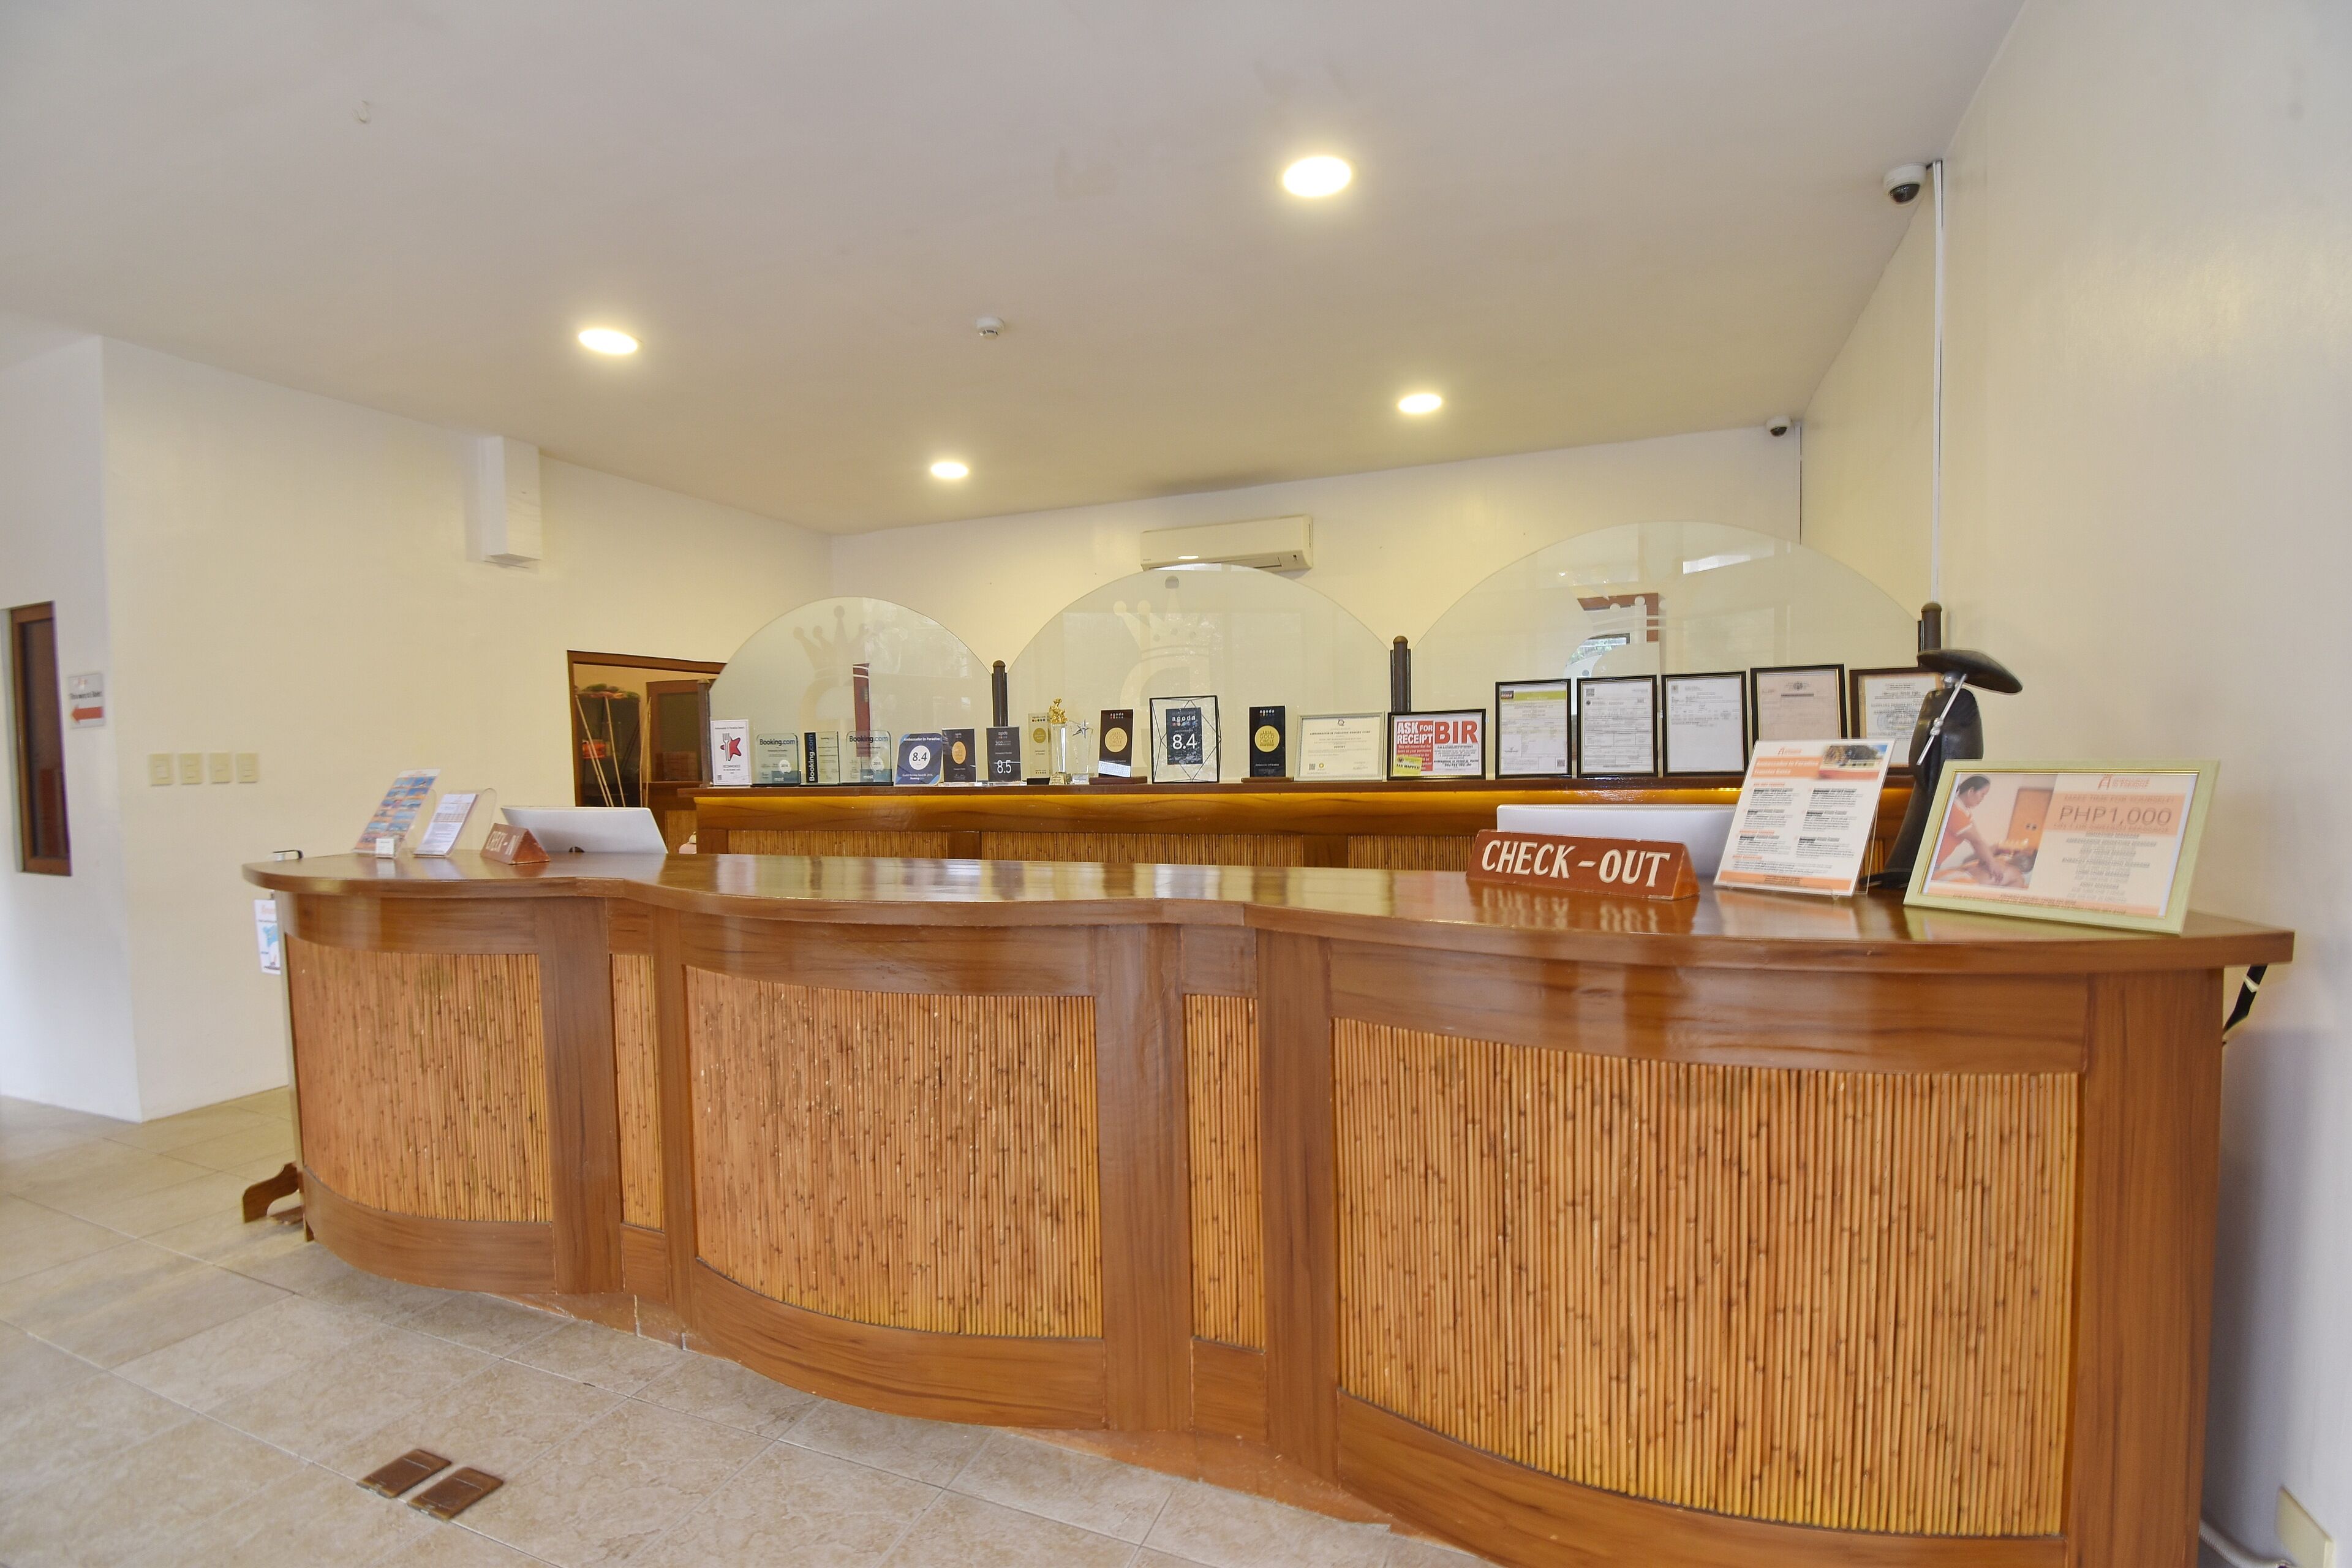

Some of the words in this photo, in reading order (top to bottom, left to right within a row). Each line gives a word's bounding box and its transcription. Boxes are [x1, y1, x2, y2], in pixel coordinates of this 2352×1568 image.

[1397, 722, 1419, 734] ASK
[1434, 721, 1478, 744] BIR
[1172, 733, 1197, 750] 8.4
[1397, 734, 1433, 745] RECEIPT
[912, 752, 927, 761] 8.4
[997, 760, 1012, 774] 8.5
[2059, 805, 2172, 826] PHP1,000
